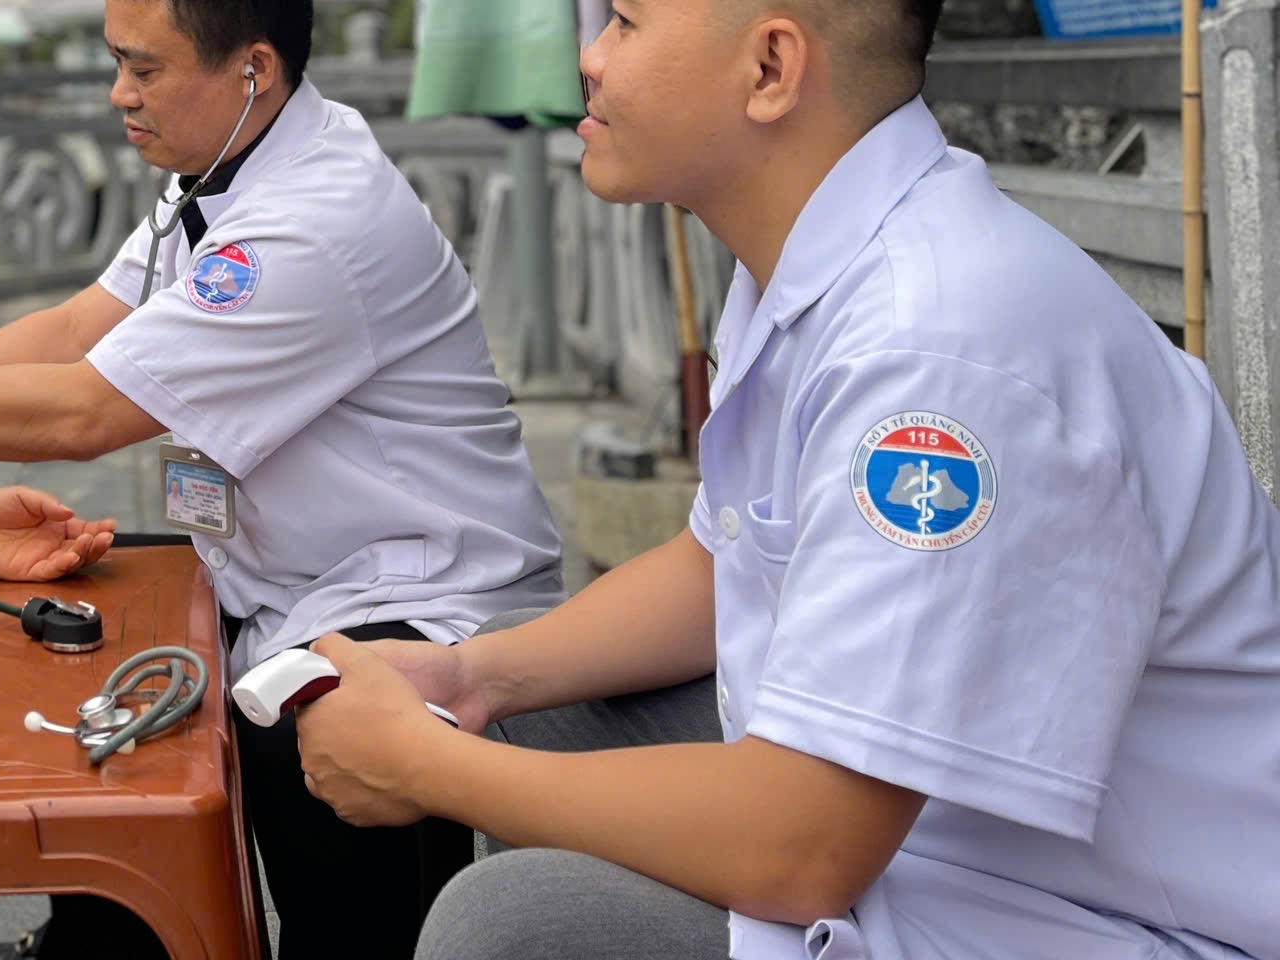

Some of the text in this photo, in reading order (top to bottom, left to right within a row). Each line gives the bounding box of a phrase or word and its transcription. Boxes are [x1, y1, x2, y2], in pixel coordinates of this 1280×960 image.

[225, 247, 239, 257] 115
[881, 424, 890, 433] Y
[910, 414, 956, 434] QUẢNG
[958, 430, 983, 459] NINH
[907, 430, 940, 447] 115
[855, 490, 876, 522] TRUNG
